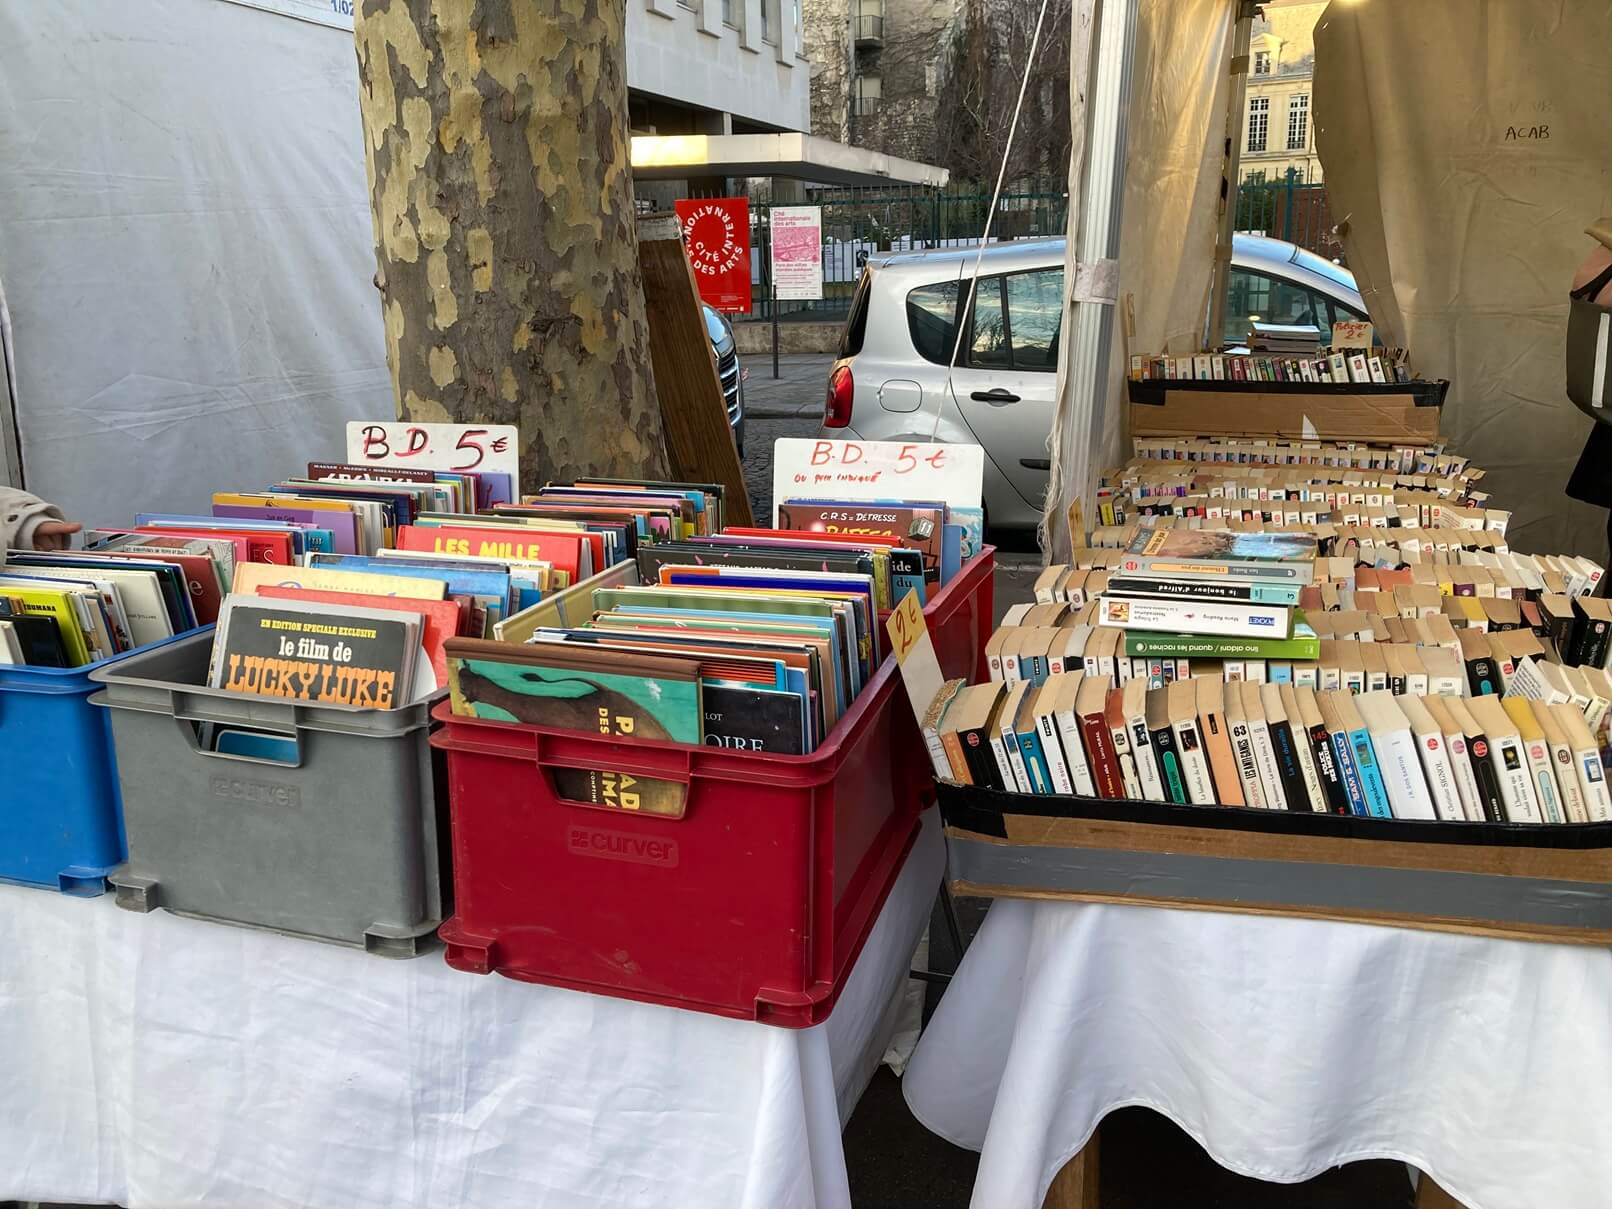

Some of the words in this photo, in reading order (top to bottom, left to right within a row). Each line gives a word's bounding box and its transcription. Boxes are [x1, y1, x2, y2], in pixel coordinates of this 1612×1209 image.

[1505, 125, 1549, 141] ACAB
[694, 260, 715, 275] DES
[720, 246, 743, 274] ARTS
[696, 241, 720, 262] CITÉ
[434, 536, 470, 556] LES
[480, 541, 540, 561] MILLE
[896, 577, 912, 589] du
[1193, 587, 1226, 596] bonjour
[260, 618, 271, 628] EN
[272, 620, 302, 631] EDITION
[302, 622, 338, 635] SPECIALE
[338, 626, 377, 639] EXCLUSIVE
[278, 635, 294, 657] le
[296, 637, 330, 660] film
[332, 641, 352, 663] de
[1188, 644, 1214, 652] quand
[225, 654, 320, 702] LUCKY
[318, 663, 396, 710] LUKE
[598, 708, 610, 735] DES
[1234, 724, 1246, 736] 63
[1312, 731, 1328, 740] 145
[1318, 751, 1330, 776] POLICE
[1337, 736, 1350, 766] SALLY
[1436, 760, 1448, 788] SIGNOL
[1348, 776, 1360, 802] SAM
[591, 832, 673, 860] curver
